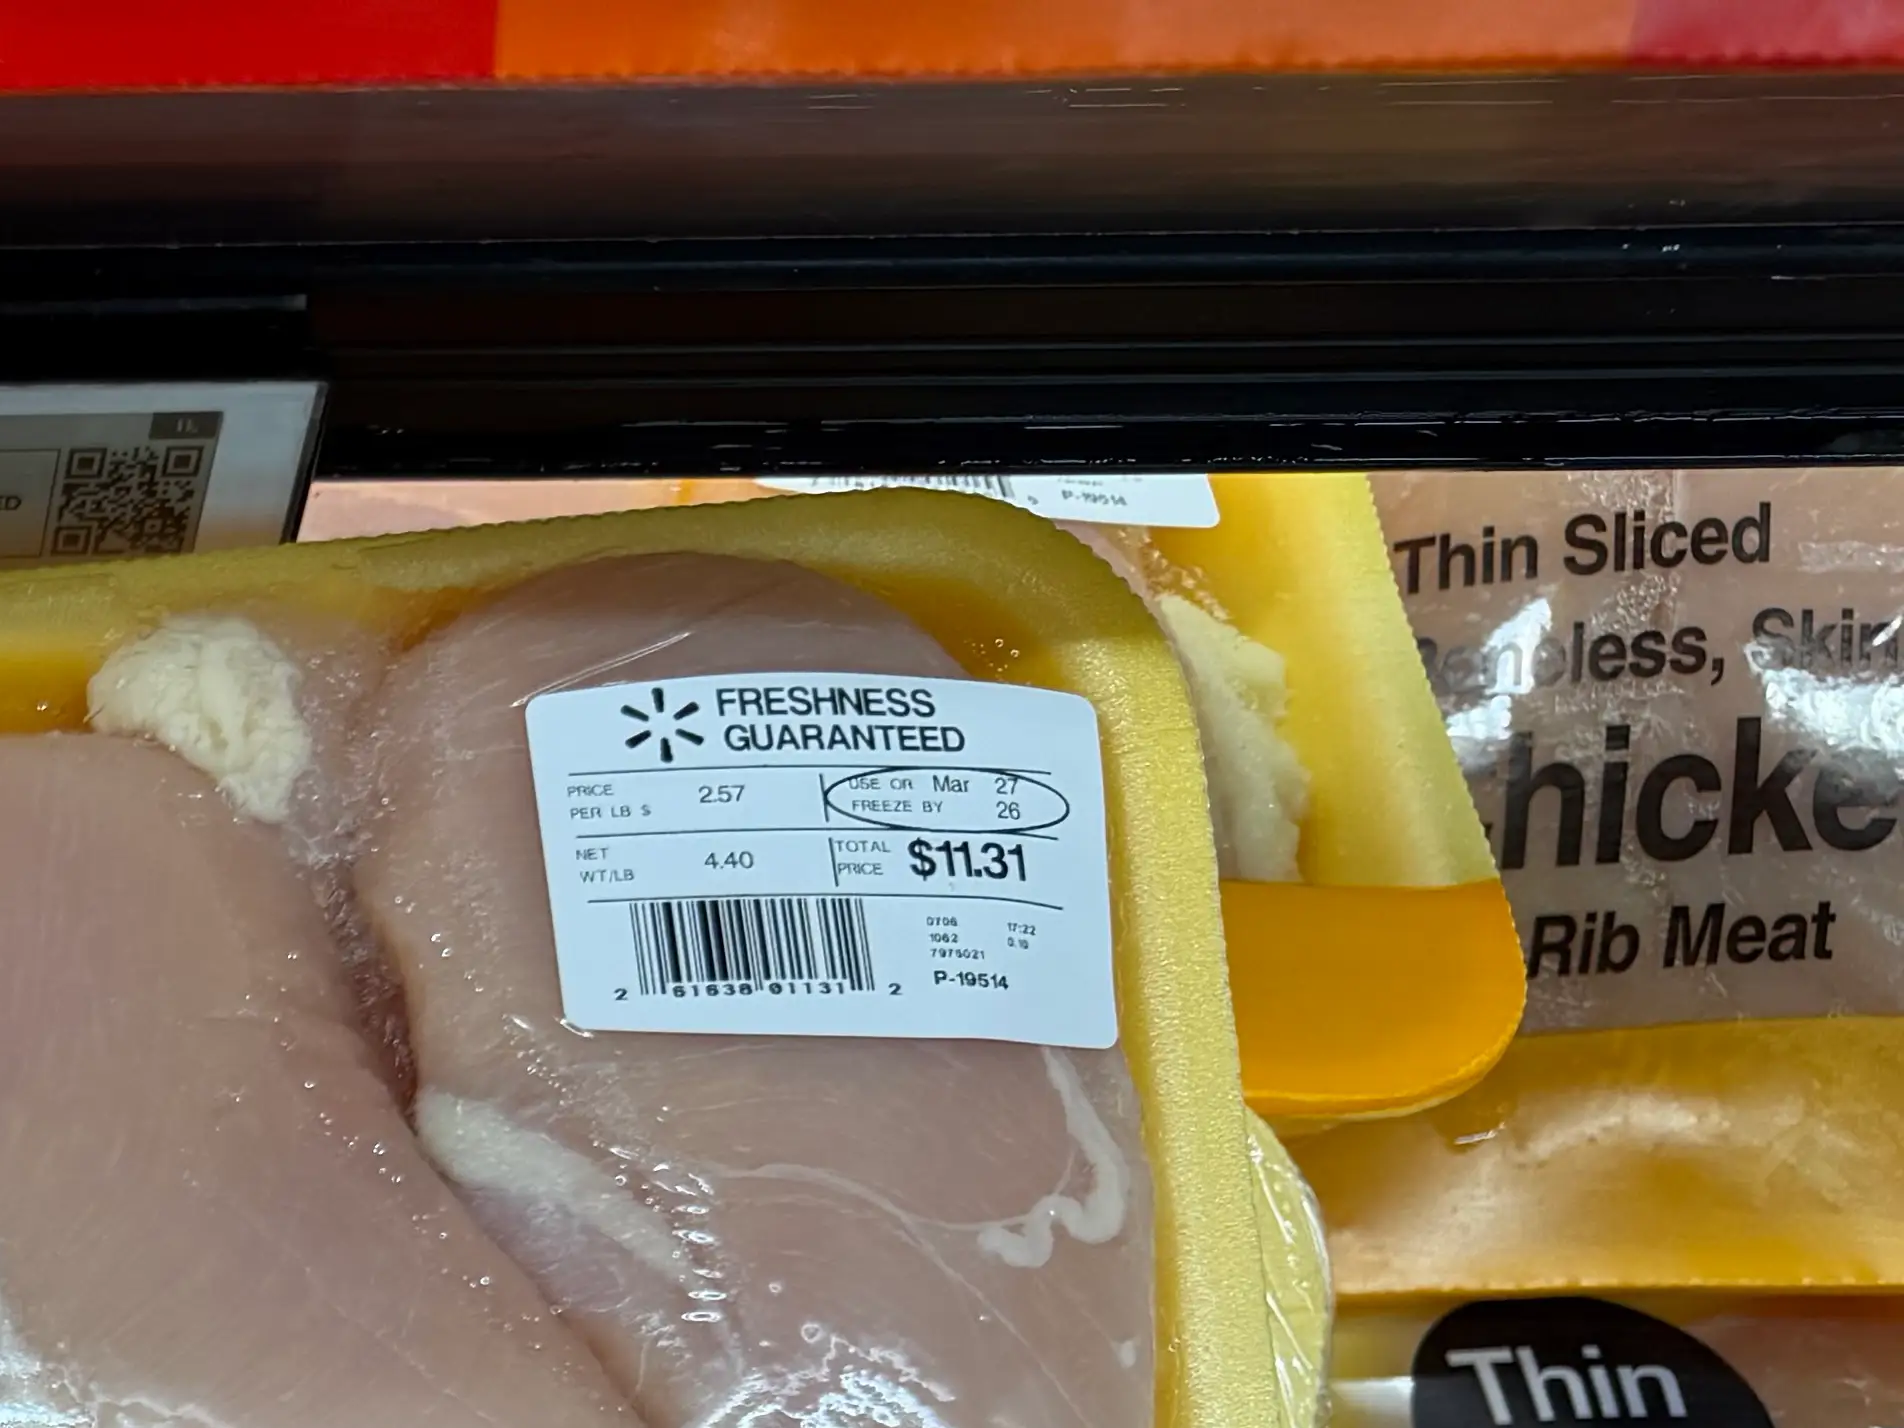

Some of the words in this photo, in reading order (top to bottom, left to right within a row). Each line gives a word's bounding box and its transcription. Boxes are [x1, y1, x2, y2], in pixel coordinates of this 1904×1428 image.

[1394, 527, 1537, 593] Thin
[1564, 502, 1771, 576] Sliced
[718, 687, 935, 718] FRESHNESS
[724, 724, 965, 752] GUARANTEED
[698, 784, 745, 804] 2.57
[890, 777, 914, 791] OR
[933, 775, 969, 794] Mar
[995, 776, 1018, 795] 27
[1482, 716, 1897, 869] hicke
[852, 799, 914, 813] FREEZE
[923, 799, 943, 814] BY
[996, 802, 1021, 820] 26
[704, 851, 754, 870] 4.40
[909, 837, 1026, 882] $11.31
[1527, 910, 1639, 978] Rib
[1663, 902, 1836, 968] Meat
[614, 988, 628, 1001] 2
[672, 982, 753, 999] 61638
[769, 980, 845, 996] 01131
[889, 983, 902, 996] 2
[934, 970, 1008, 990] P-19514
[1445, 1345, 1687, 1425] Thin
